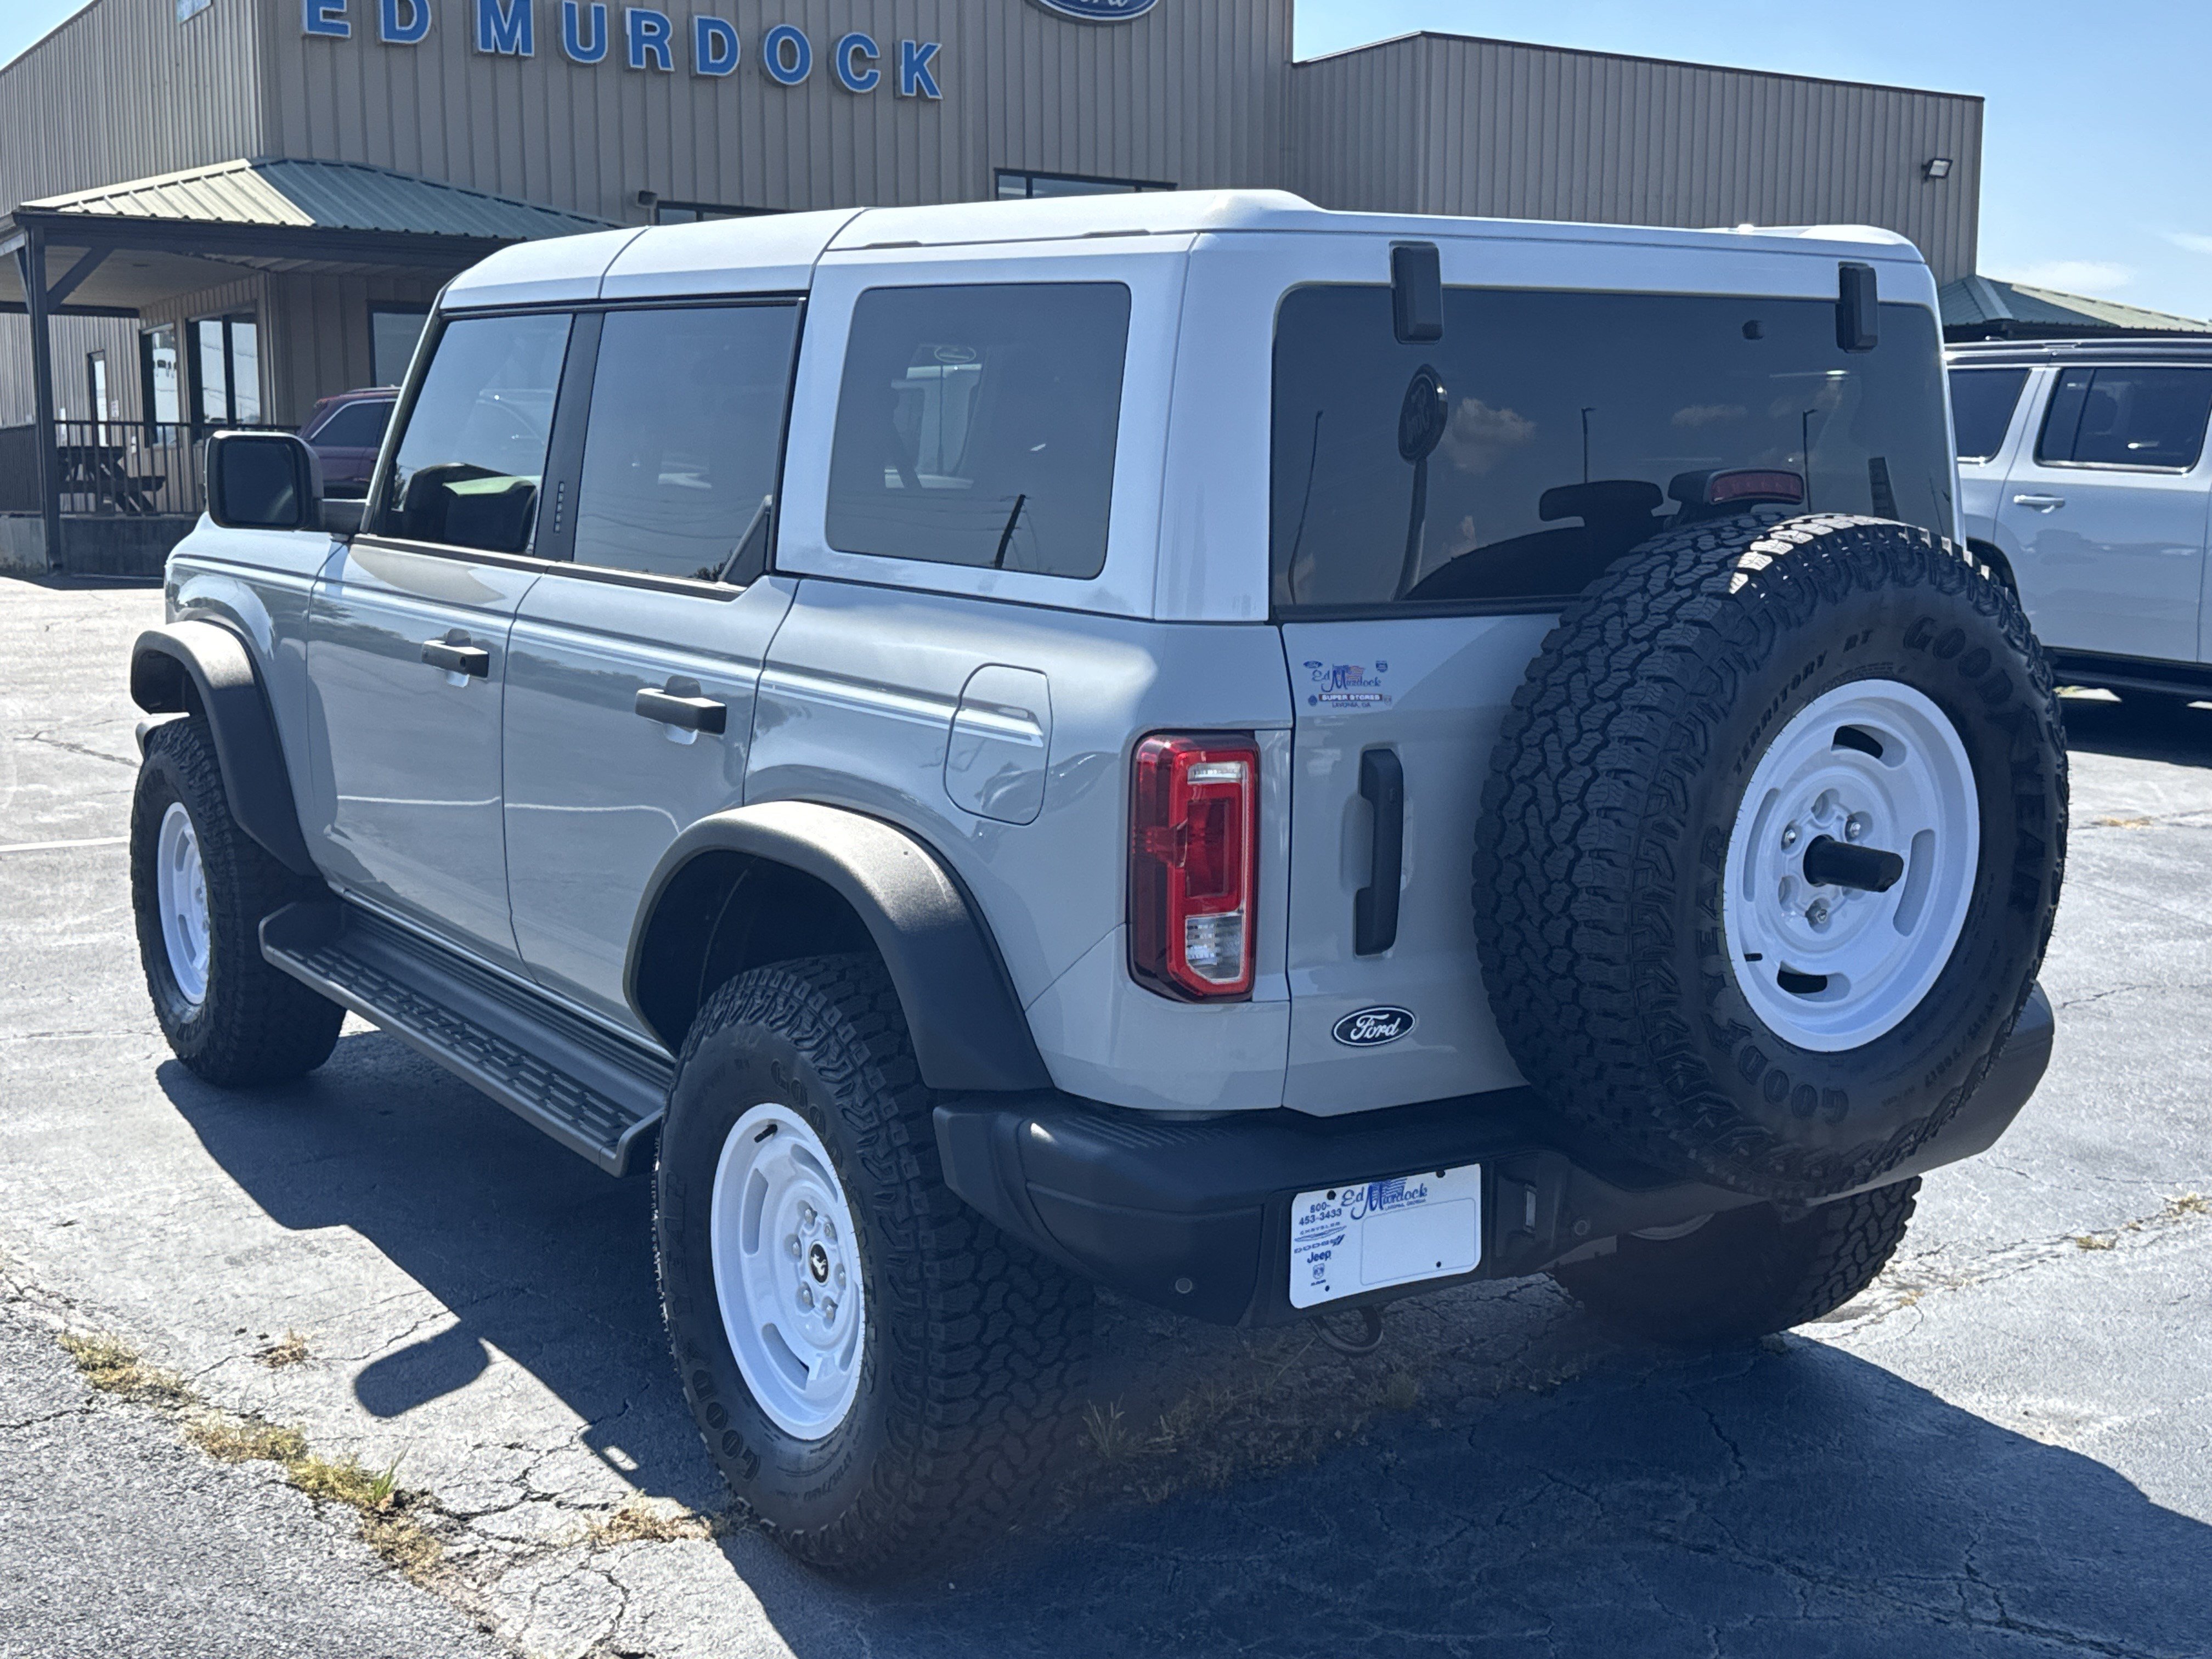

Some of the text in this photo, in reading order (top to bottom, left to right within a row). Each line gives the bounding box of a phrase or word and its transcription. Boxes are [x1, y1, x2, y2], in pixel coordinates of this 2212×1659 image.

[302, 0, 943, 101] ED MURDOCK
[1312, 669, 1381, 692] Ed Murdock
[1350, 1013, 1401, 1040] Ford
[1310, 1201, 1330, 1214] 800-
[1341, 1183, 1427, 1220] Ed Murdock
[1299, 1208, 1342, 1226] 453-3433
[1307, 1250, 1331, 1263] Jeep
